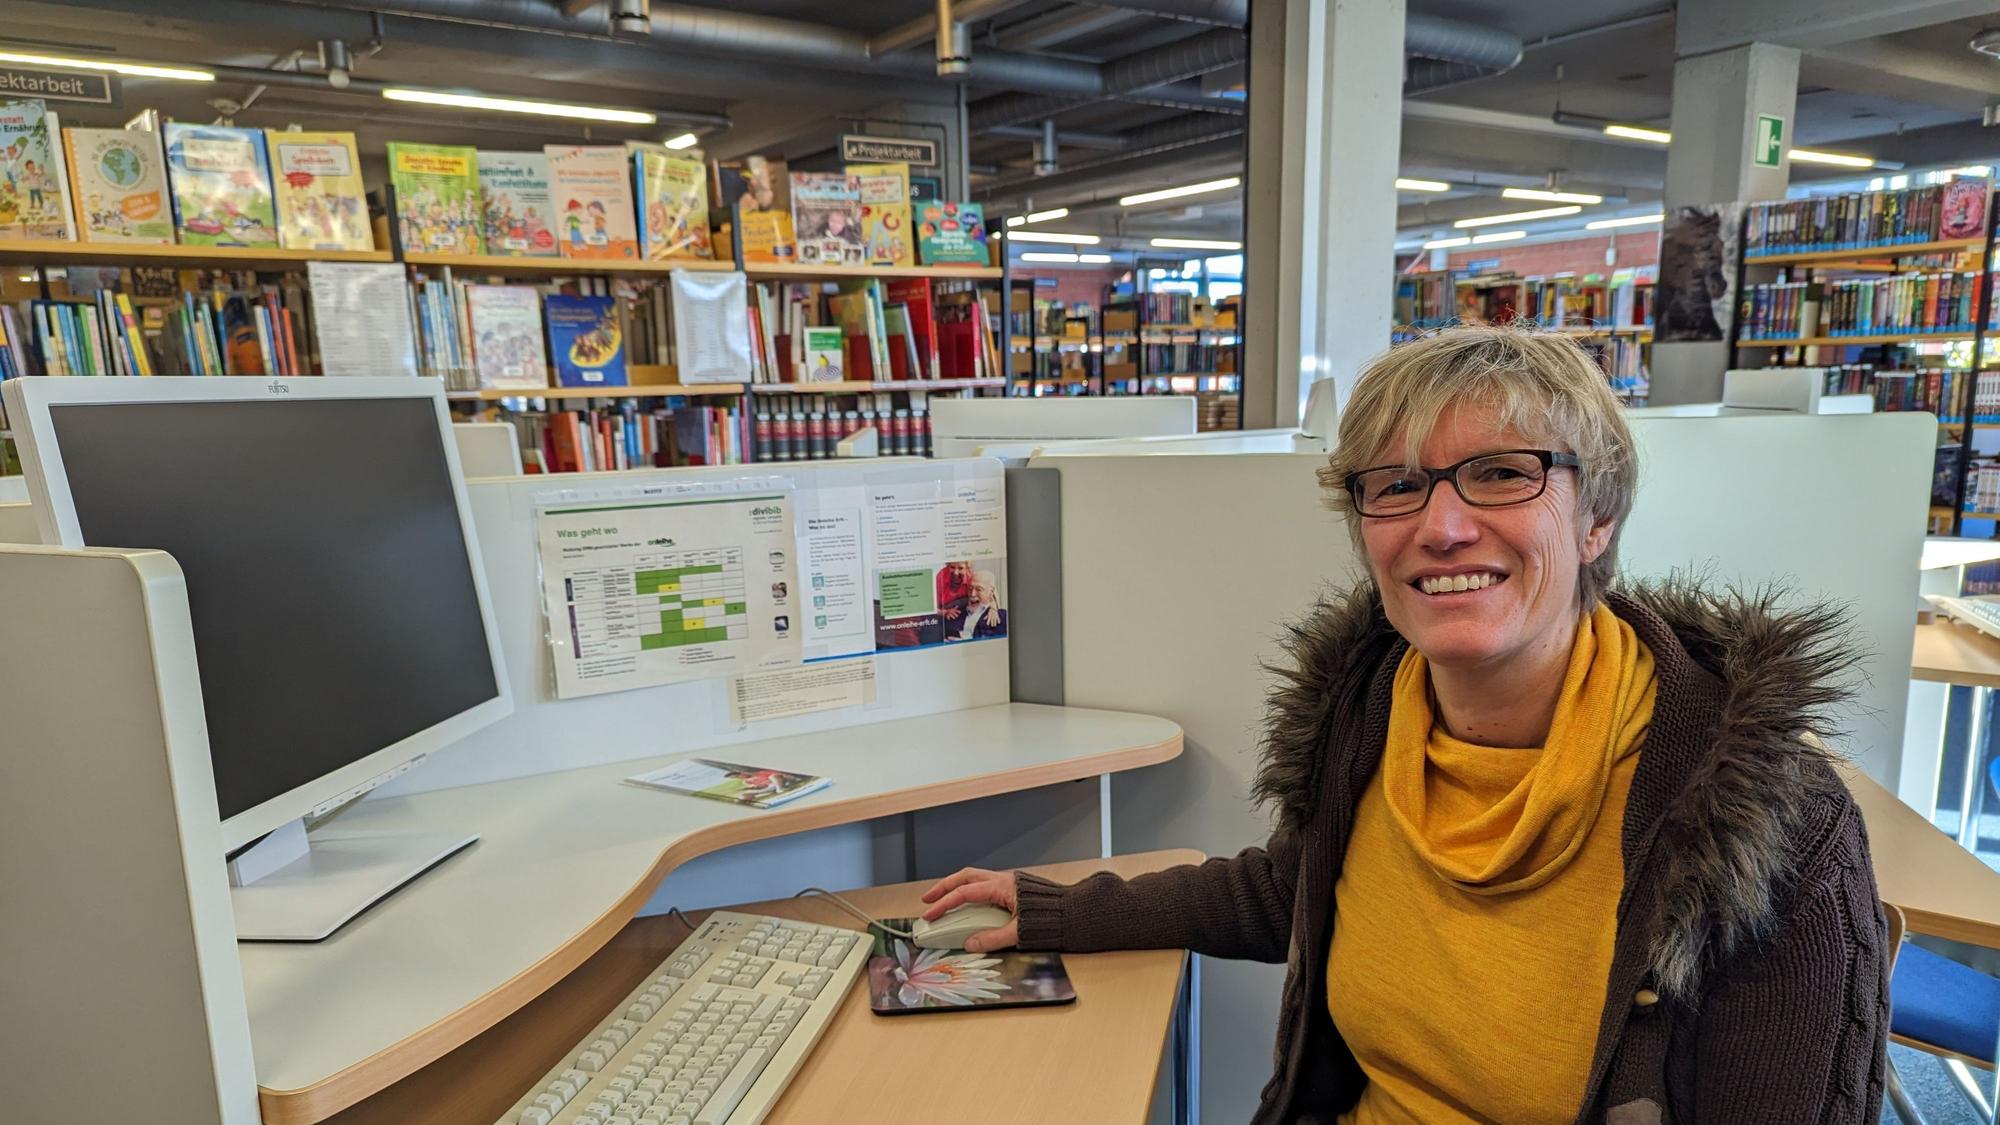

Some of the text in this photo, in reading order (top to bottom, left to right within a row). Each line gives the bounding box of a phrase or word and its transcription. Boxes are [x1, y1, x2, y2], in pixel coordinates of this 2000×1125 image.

[859, 143, 921, 161] Projektarbeit
[557, 527, 618, 538] Was geht wo
[880, 618, 938, 630] www.onleihe-erft.de
